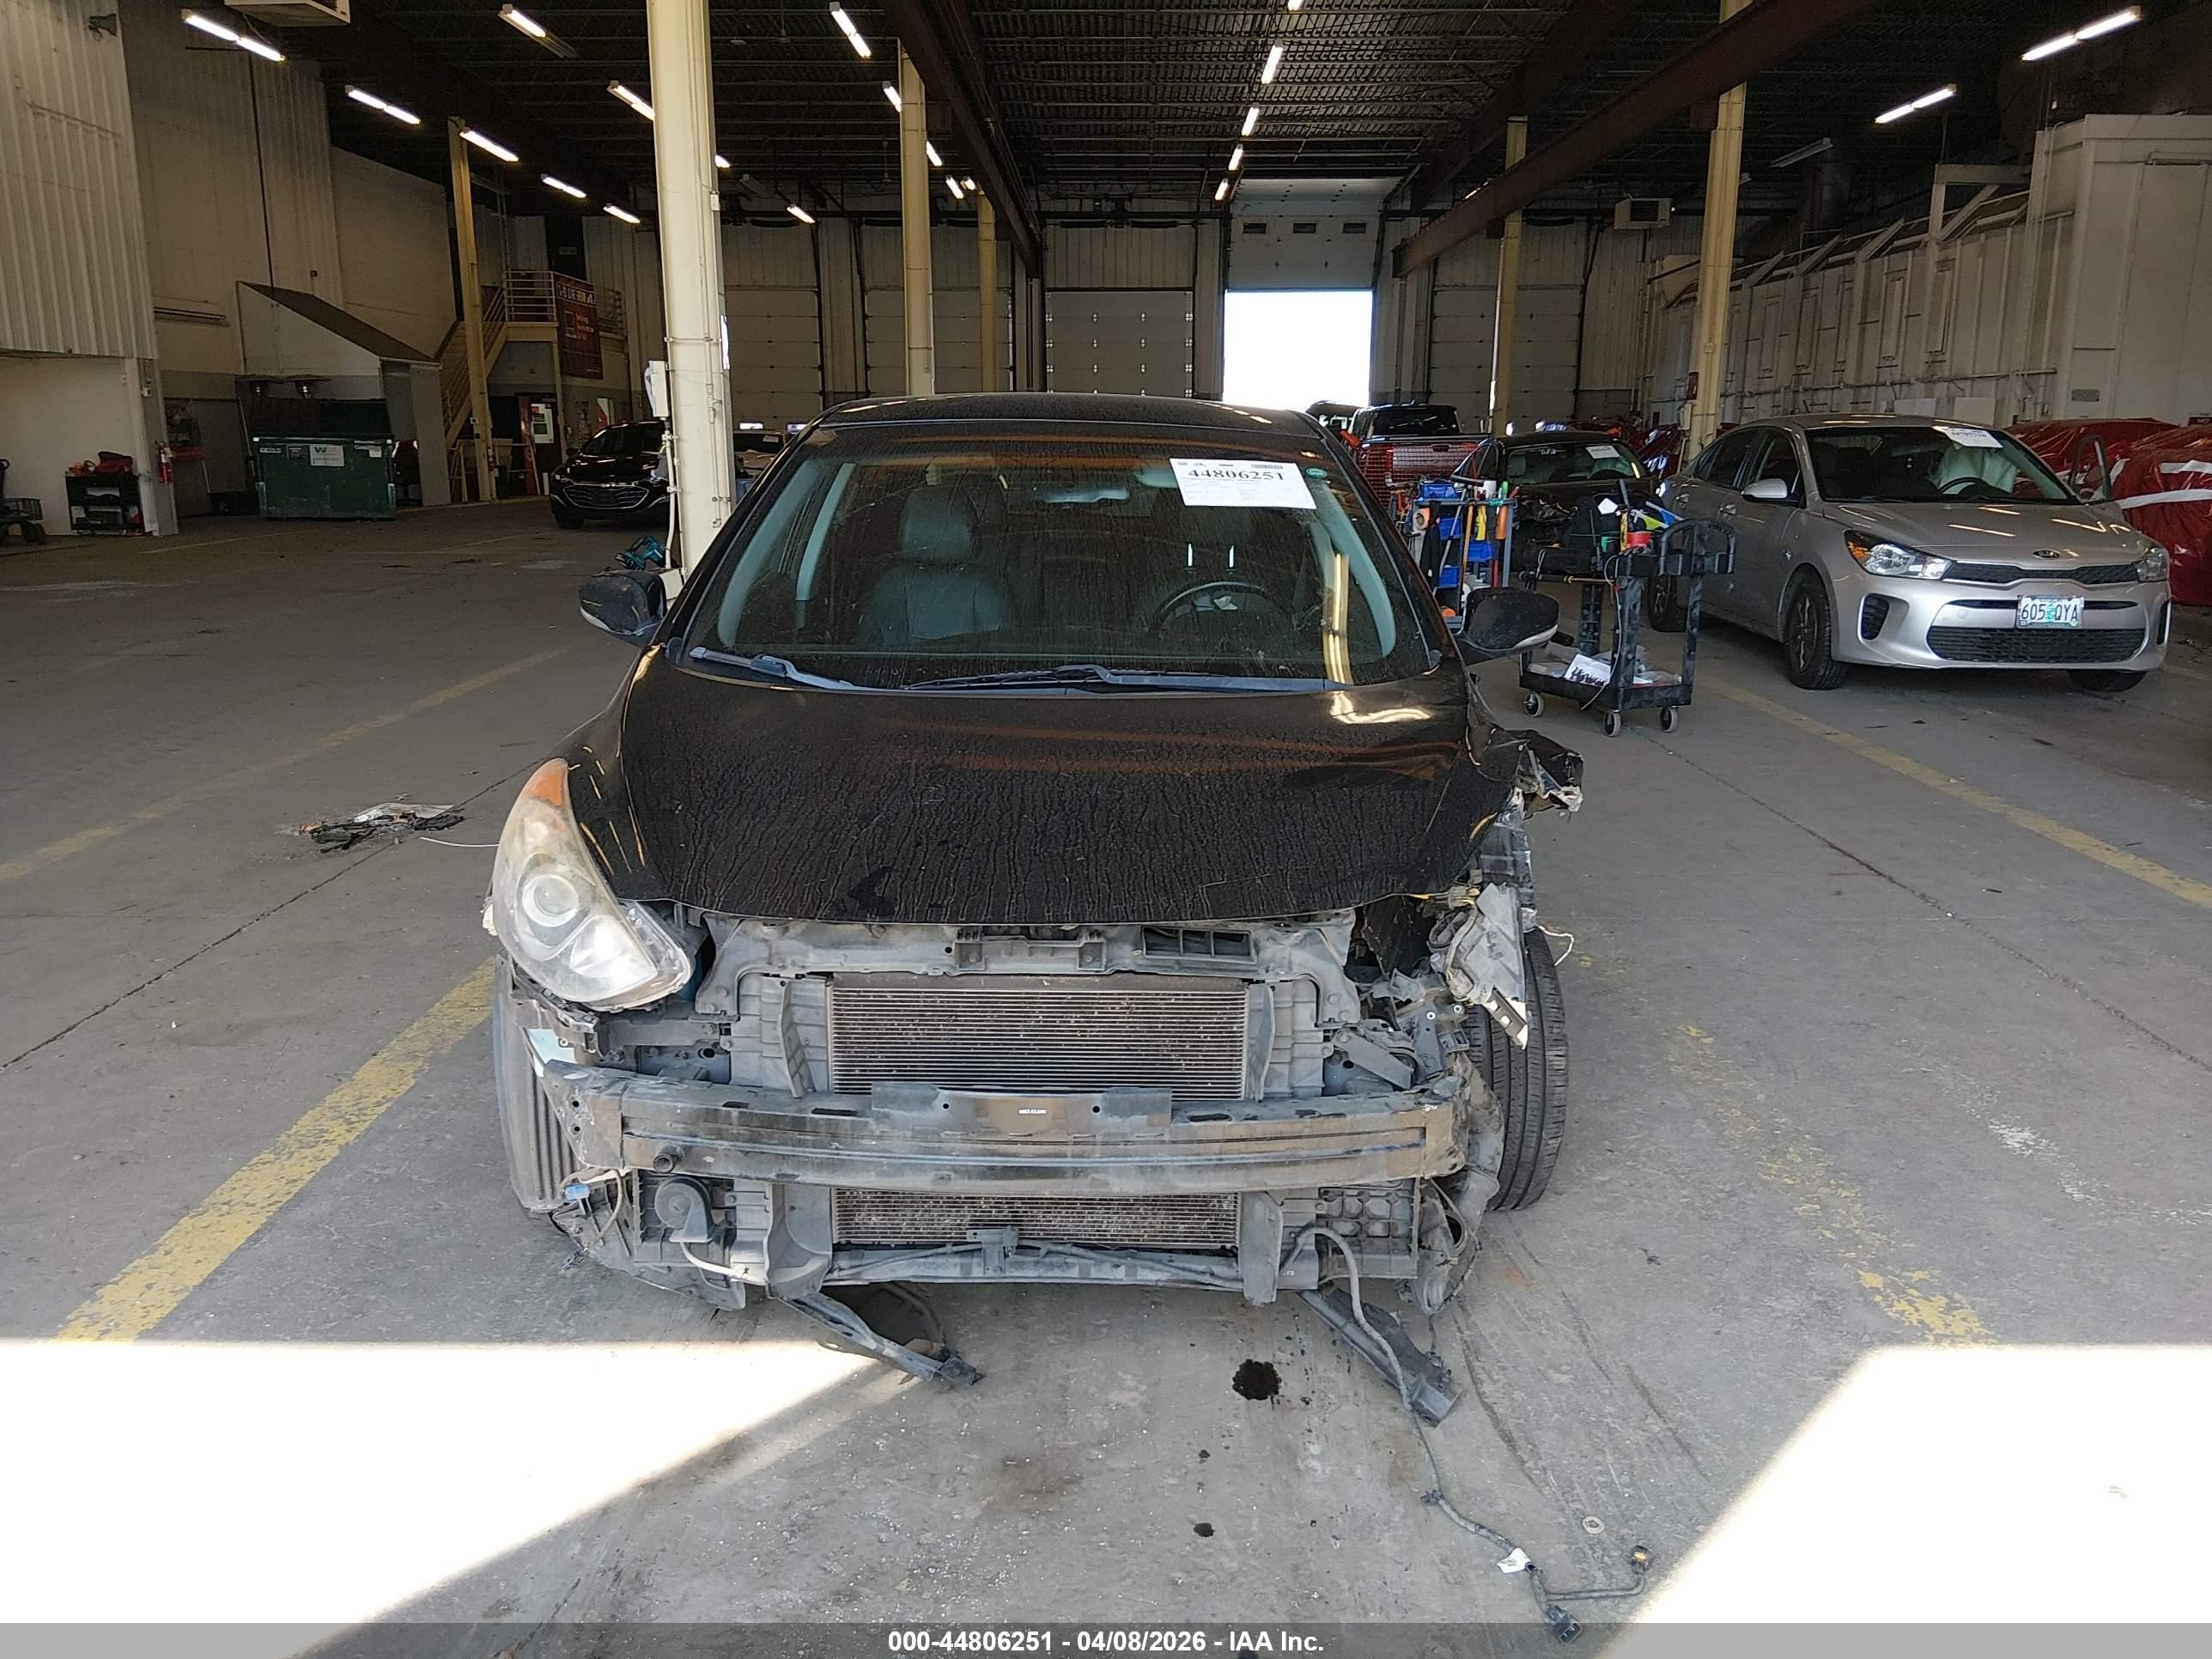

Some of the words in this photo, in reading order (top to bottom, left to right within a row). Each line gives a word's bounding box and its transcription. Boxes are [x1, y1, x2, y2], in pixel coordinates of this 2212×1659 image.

[1188, 468, 1285, 481] 44806251
[2021, 604, 2046, 620] 605
[2055, 605, 2078, 621] QYA
